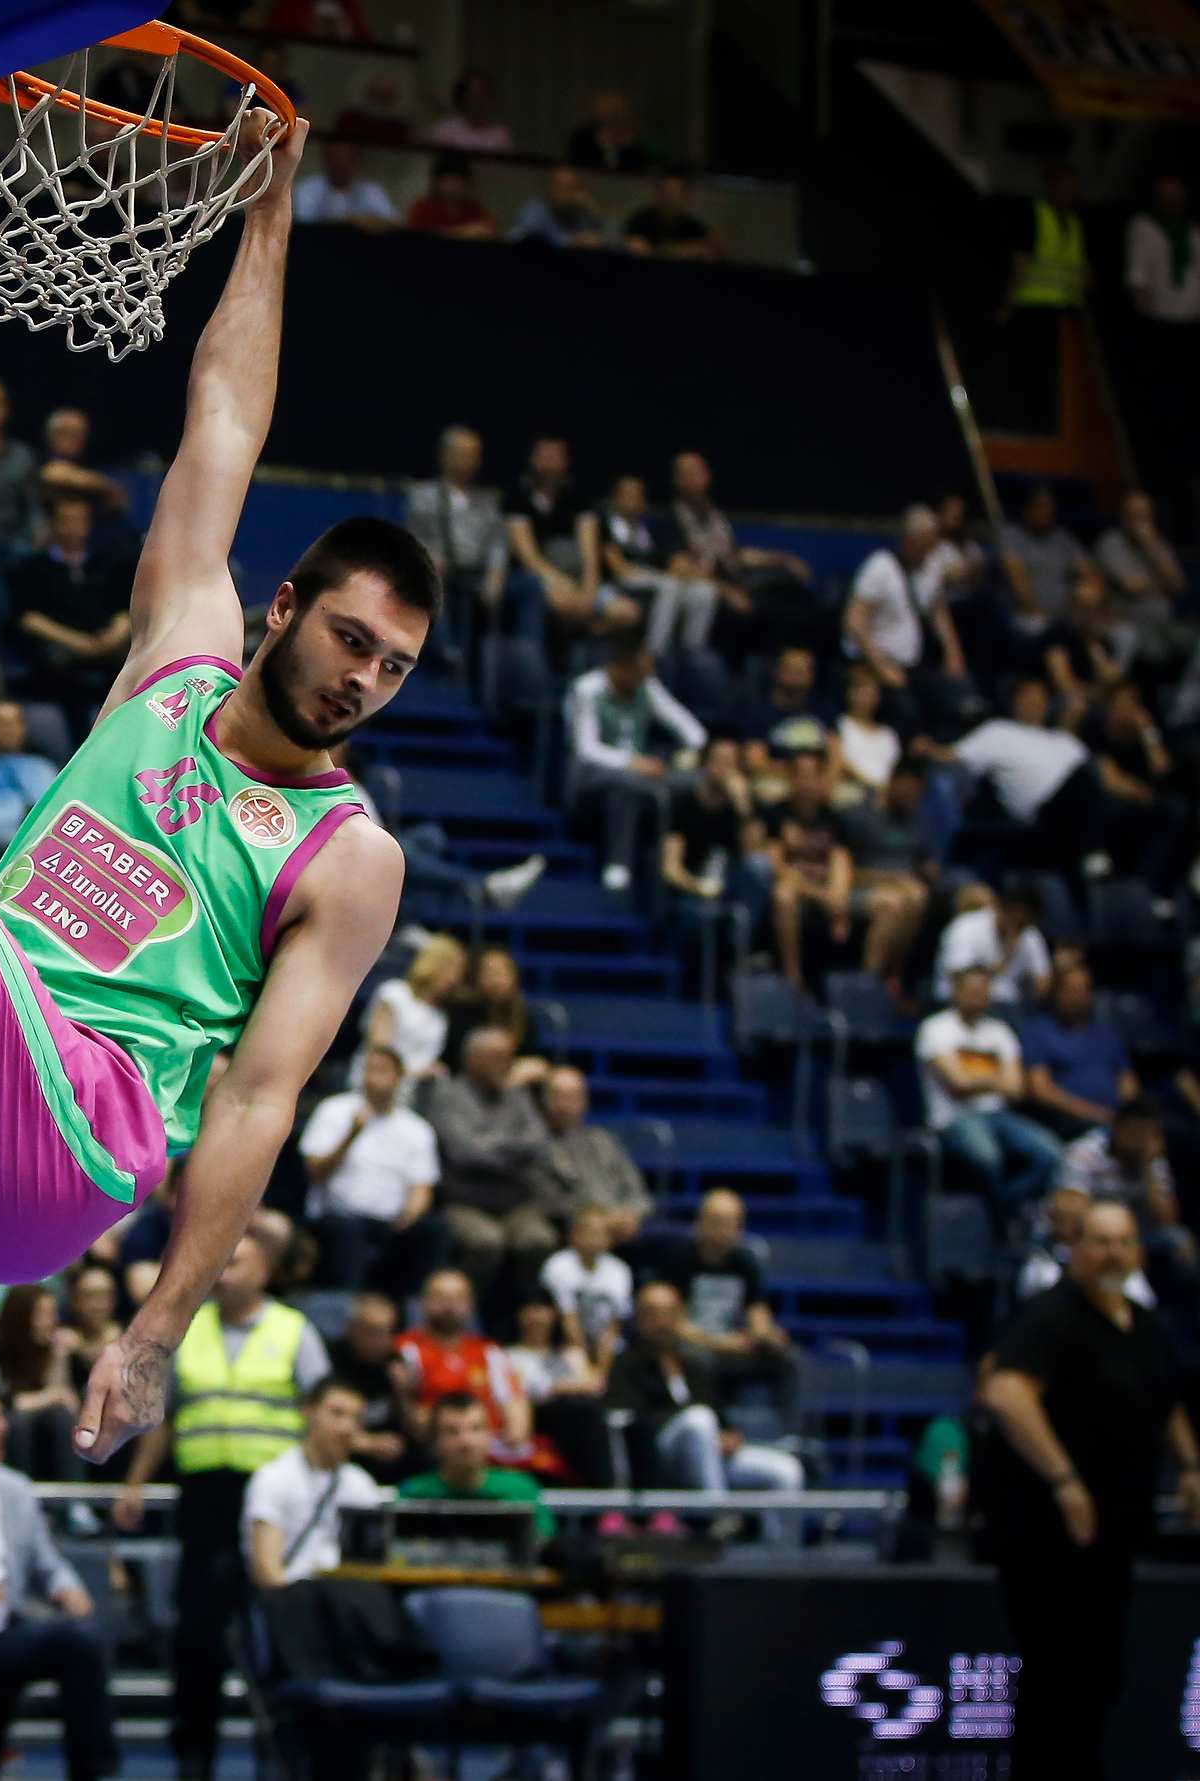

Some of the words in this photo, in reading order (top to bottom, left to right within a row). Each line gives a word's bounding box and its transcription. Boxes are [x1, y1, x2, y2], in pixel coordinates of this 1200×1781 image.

[134, 757, 223, 835] 45
[57, 858, 137, 931] Eurolux
[78, 827, 171, 908] FABER
[31, 891, 90, 939] LINO
